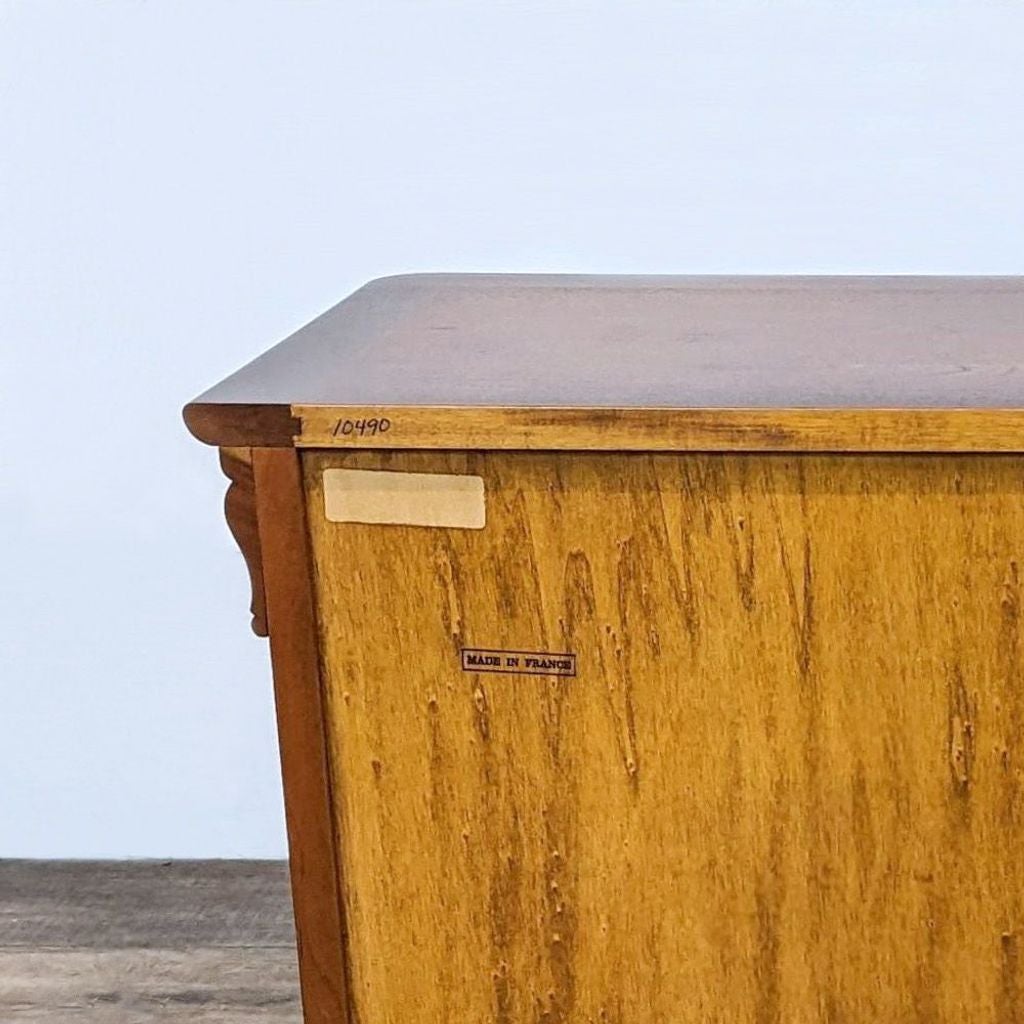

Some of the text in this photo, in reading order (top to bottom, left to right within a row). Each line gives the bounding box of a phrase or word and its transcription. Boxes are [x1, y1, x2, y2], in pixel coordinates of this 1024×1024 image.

[332, 418, 391, 436] 10490
[467, 655, 571, 670] MADE IN FRANCE
